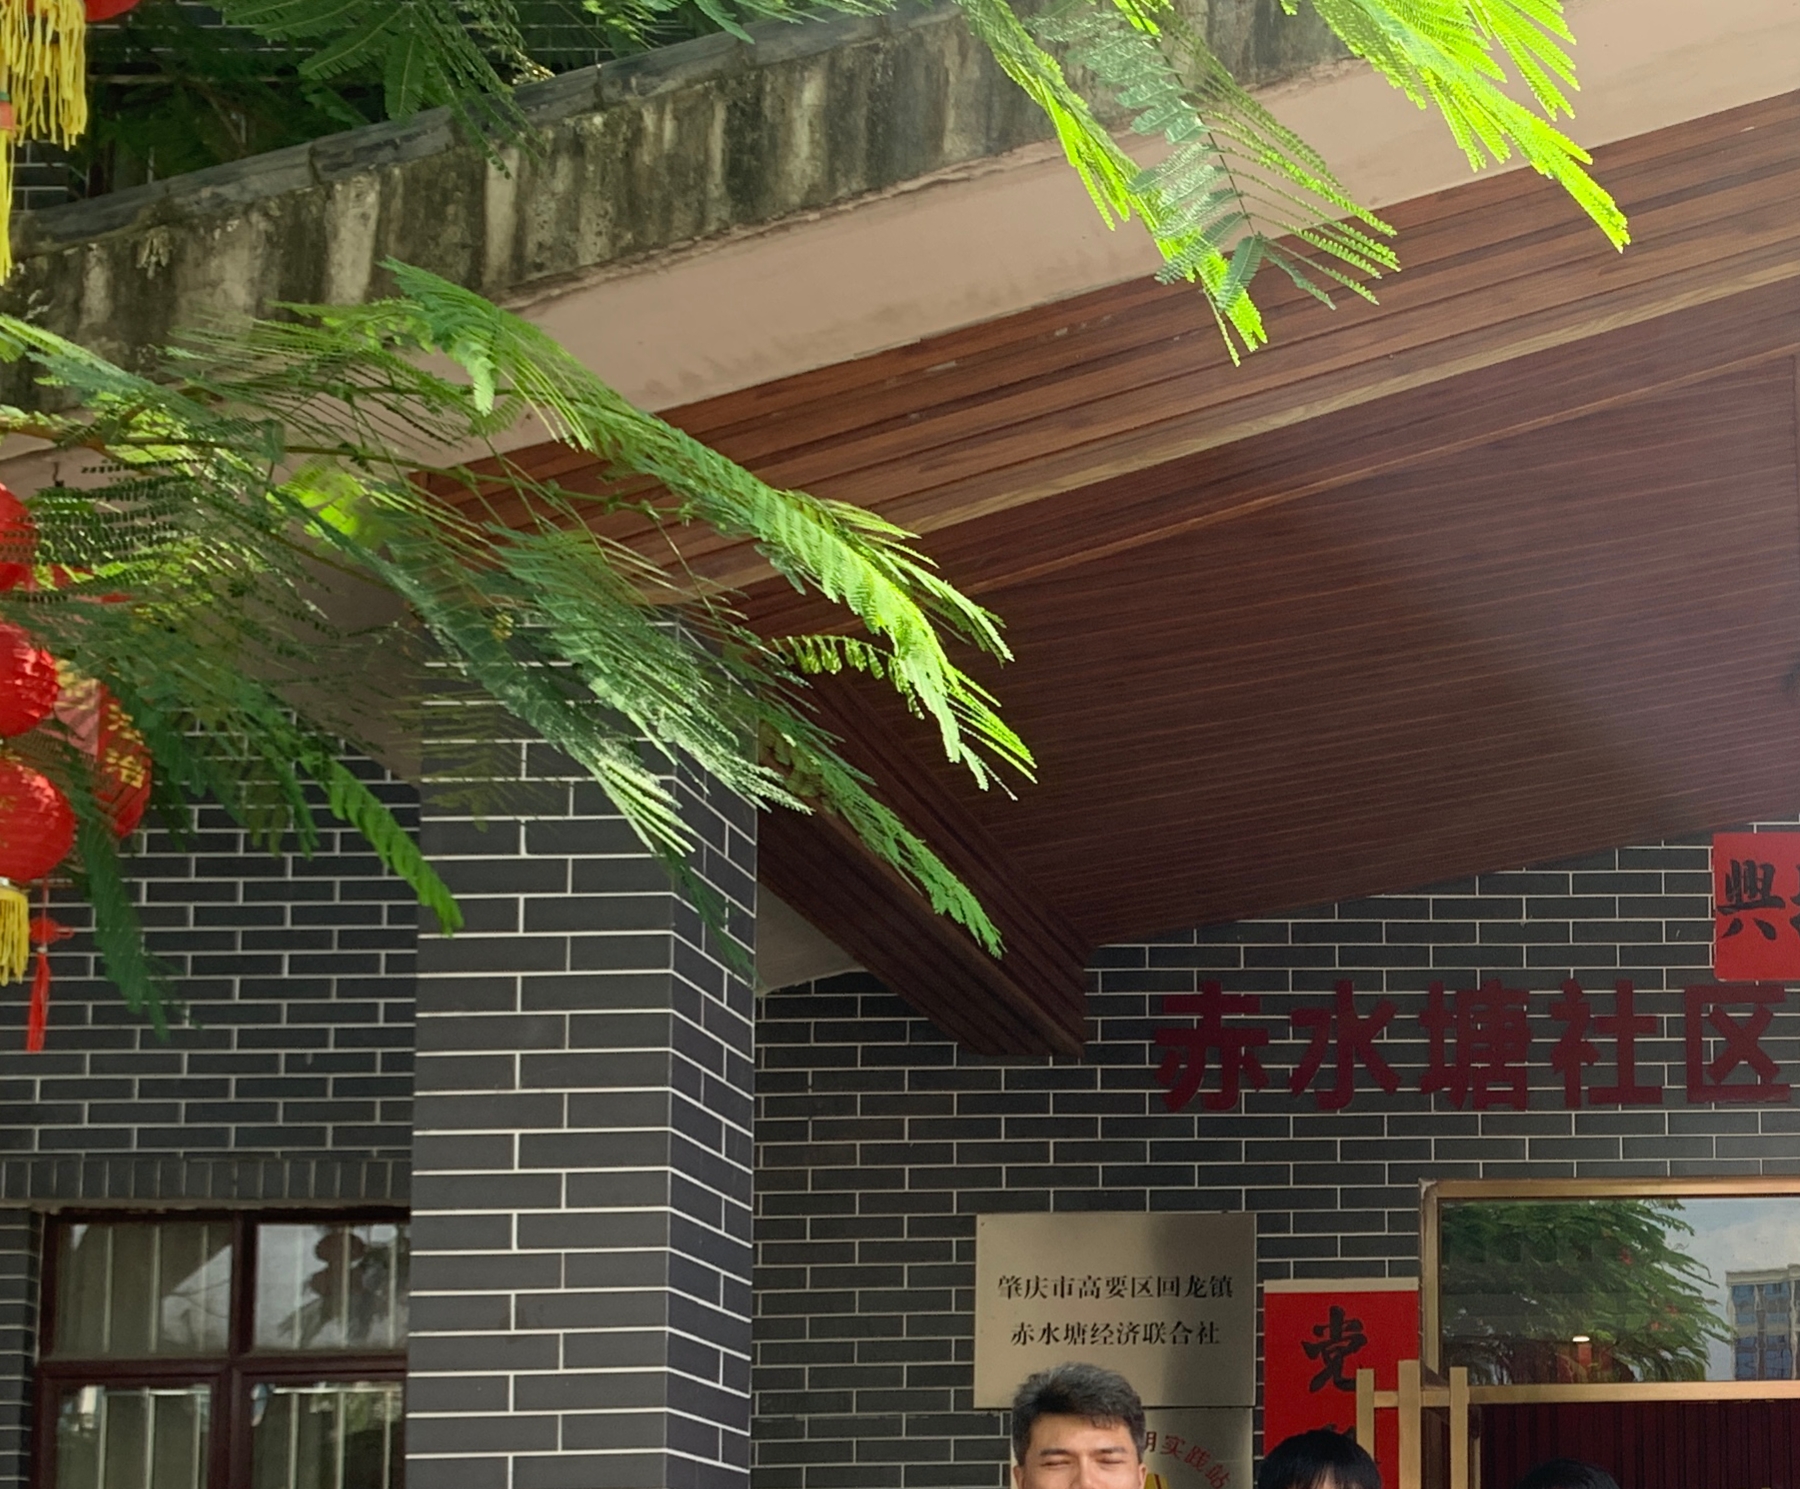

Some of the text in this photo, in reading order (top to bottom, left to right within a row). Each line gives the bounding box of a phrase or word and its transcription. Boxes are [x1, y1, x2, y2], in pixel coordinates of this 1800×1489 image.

[998, 1275, 1234, 1300] 肇庆市高要区回龙镇
[1010, 1321, 1221, 1346] 赤水塘经济联合社
